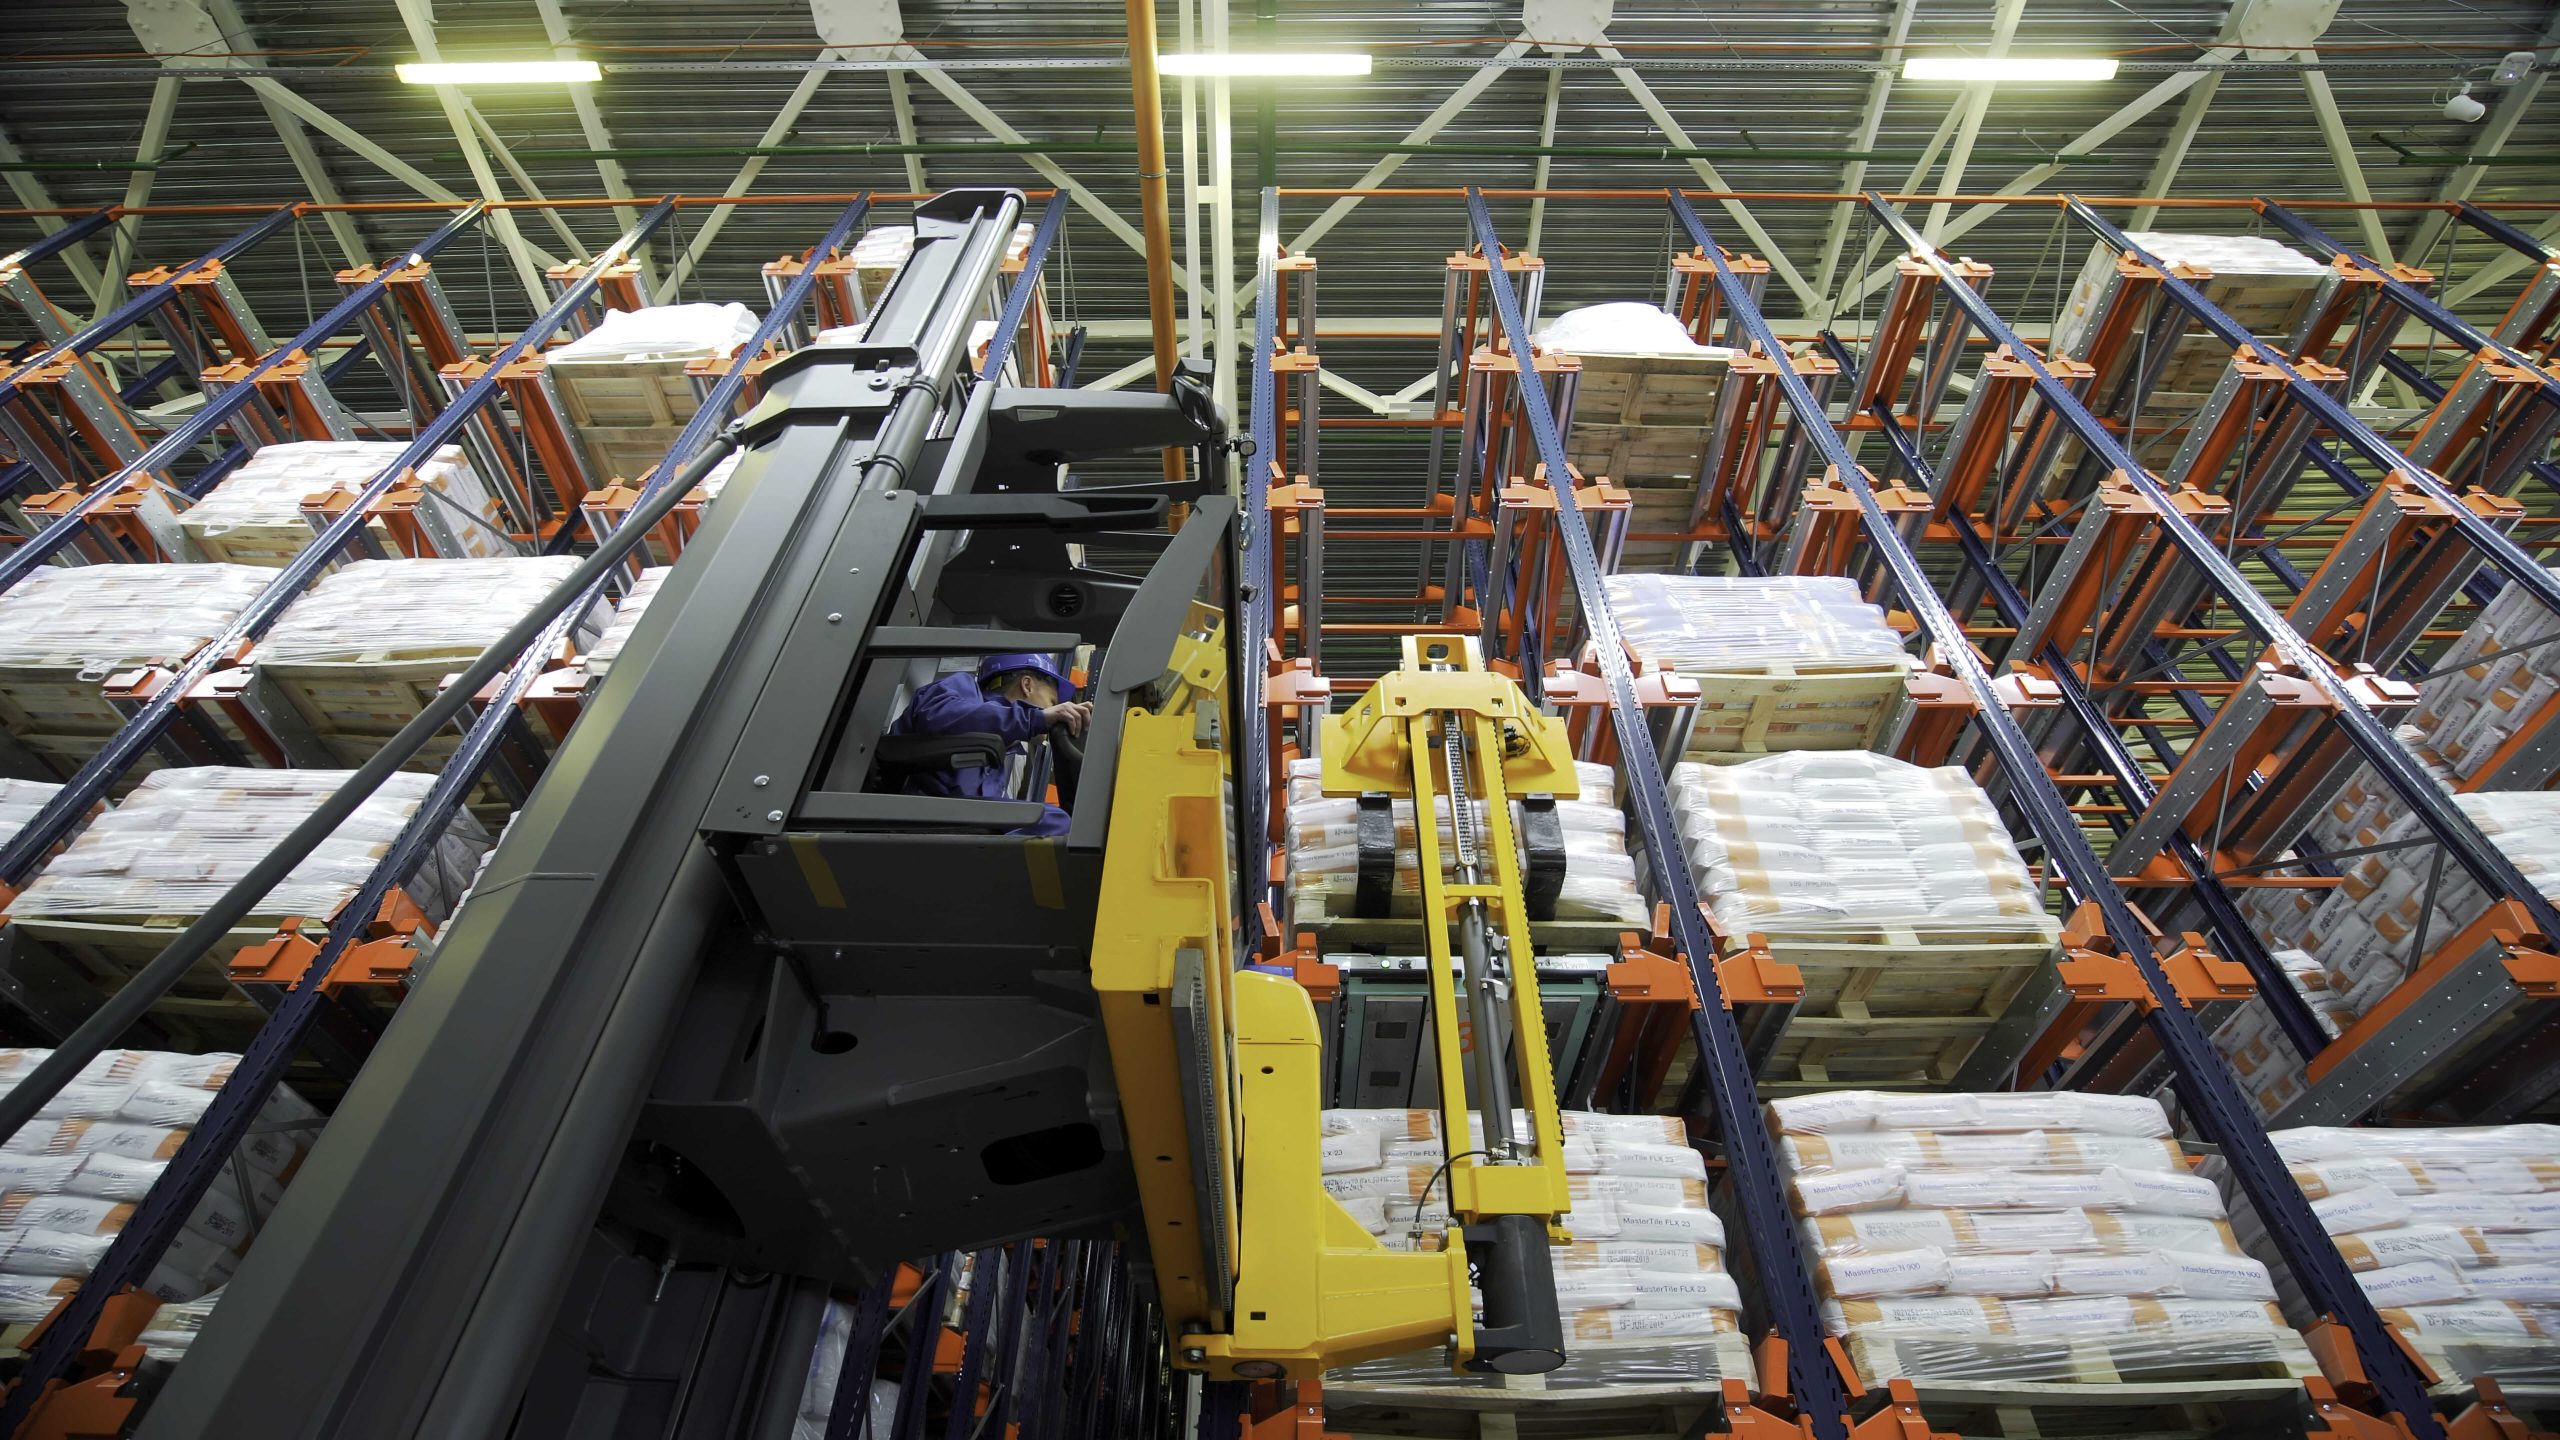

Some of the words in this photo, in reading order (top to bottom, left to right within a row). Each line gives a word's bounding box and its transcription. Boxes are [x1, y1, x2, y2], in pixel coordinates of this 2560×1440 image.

[1623, 1217, 1663, 1226] MasterTile
[1681, 1220, 1691, 1228] 23
[1844, 1264, 1898, 1278] MasterEmaco
[1906, 1262, 1921, 1271] 900
[1635, 1285, 1678, 1293] MasterTile
[1680, 1285, 1695, 1293] FLX
[1697, 1285, 1707, 1293] 23
